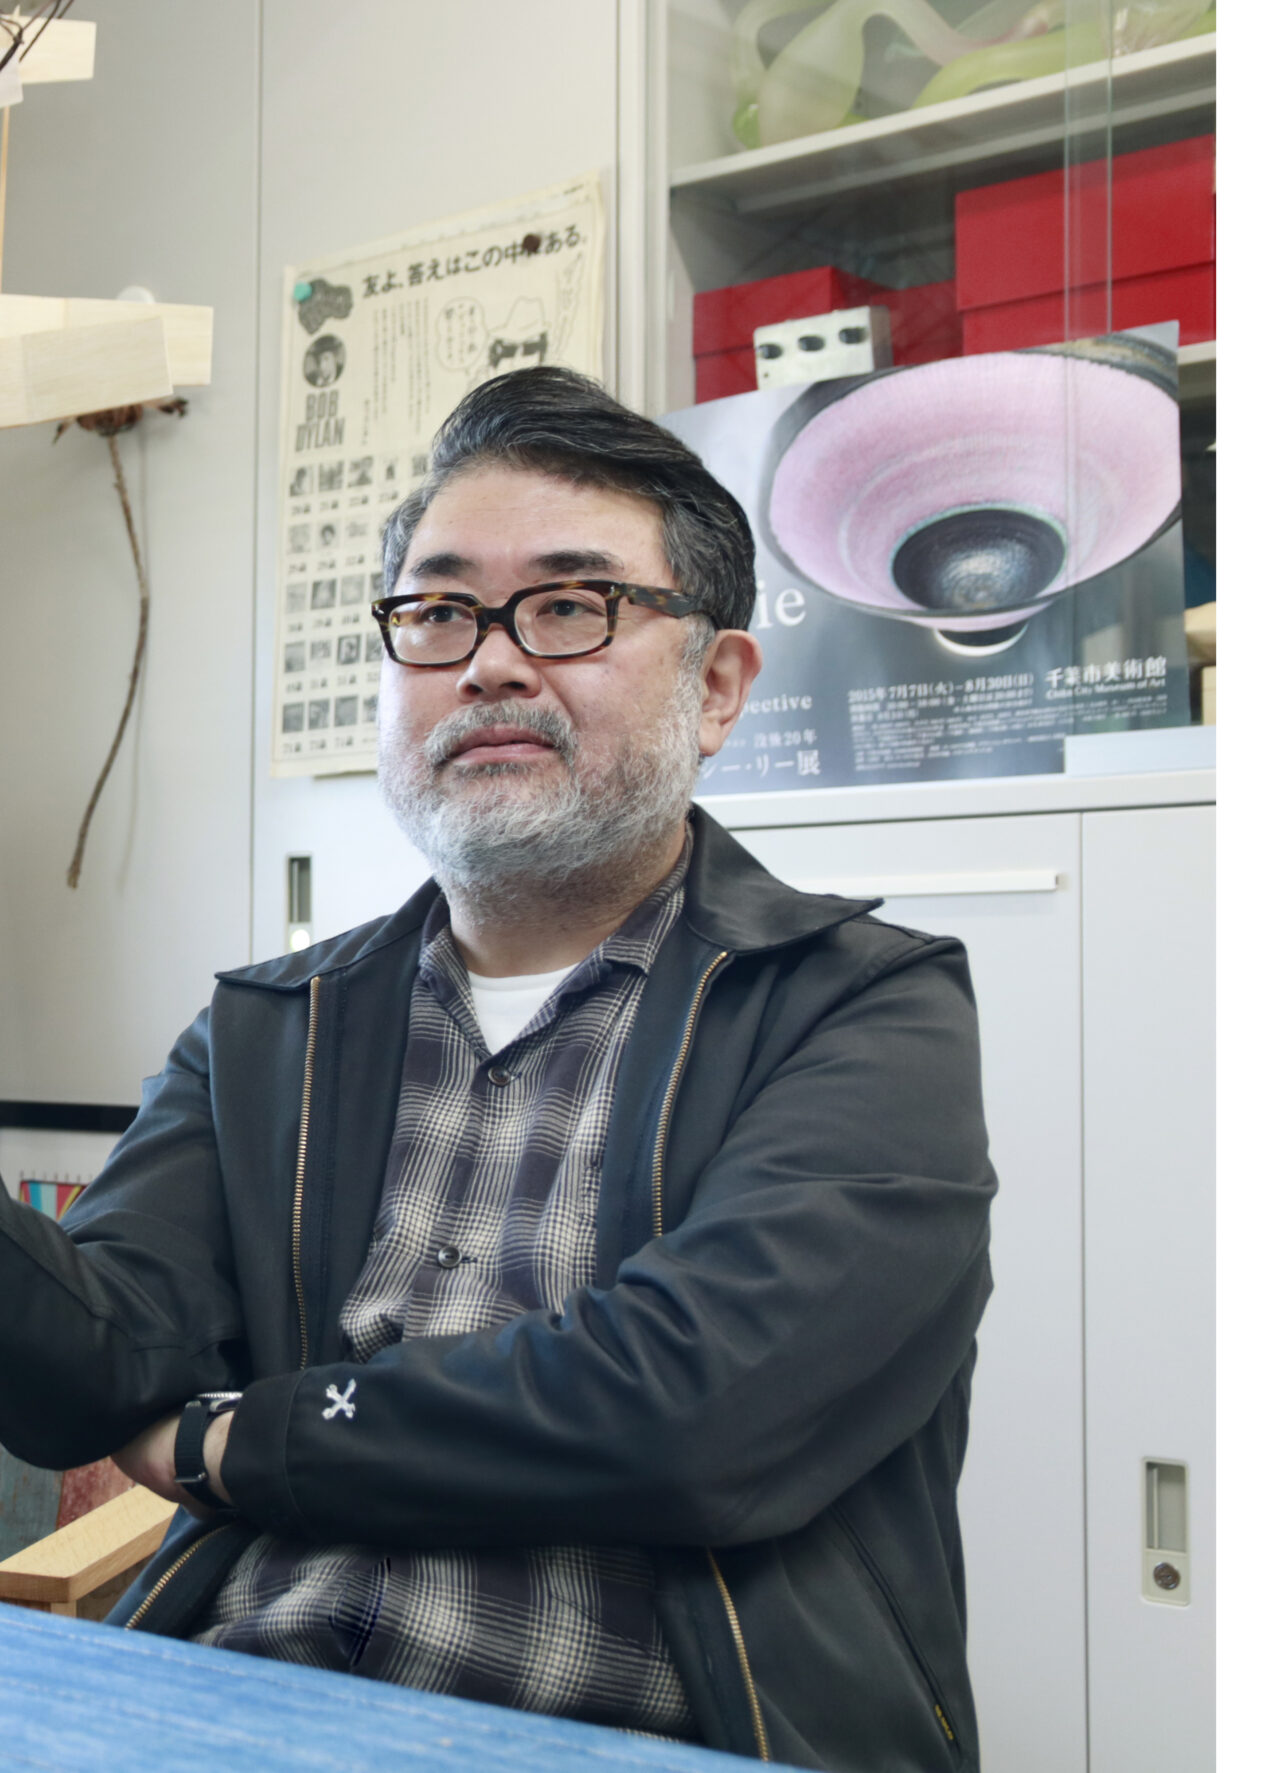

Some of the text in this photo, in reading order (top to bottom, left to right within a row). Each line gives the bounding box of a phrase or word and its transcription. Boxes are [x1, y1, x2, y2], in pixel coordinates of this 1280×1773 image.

[361, 224, 587, 298] 友よ、答えはこの中ある。
[305, 389, 339, 422] BOB
[295, 417, 346, 452] DYLAN
[755, 579, 806, 629] ie
[1045, 655, 1167, 688] 千葉市美術館
